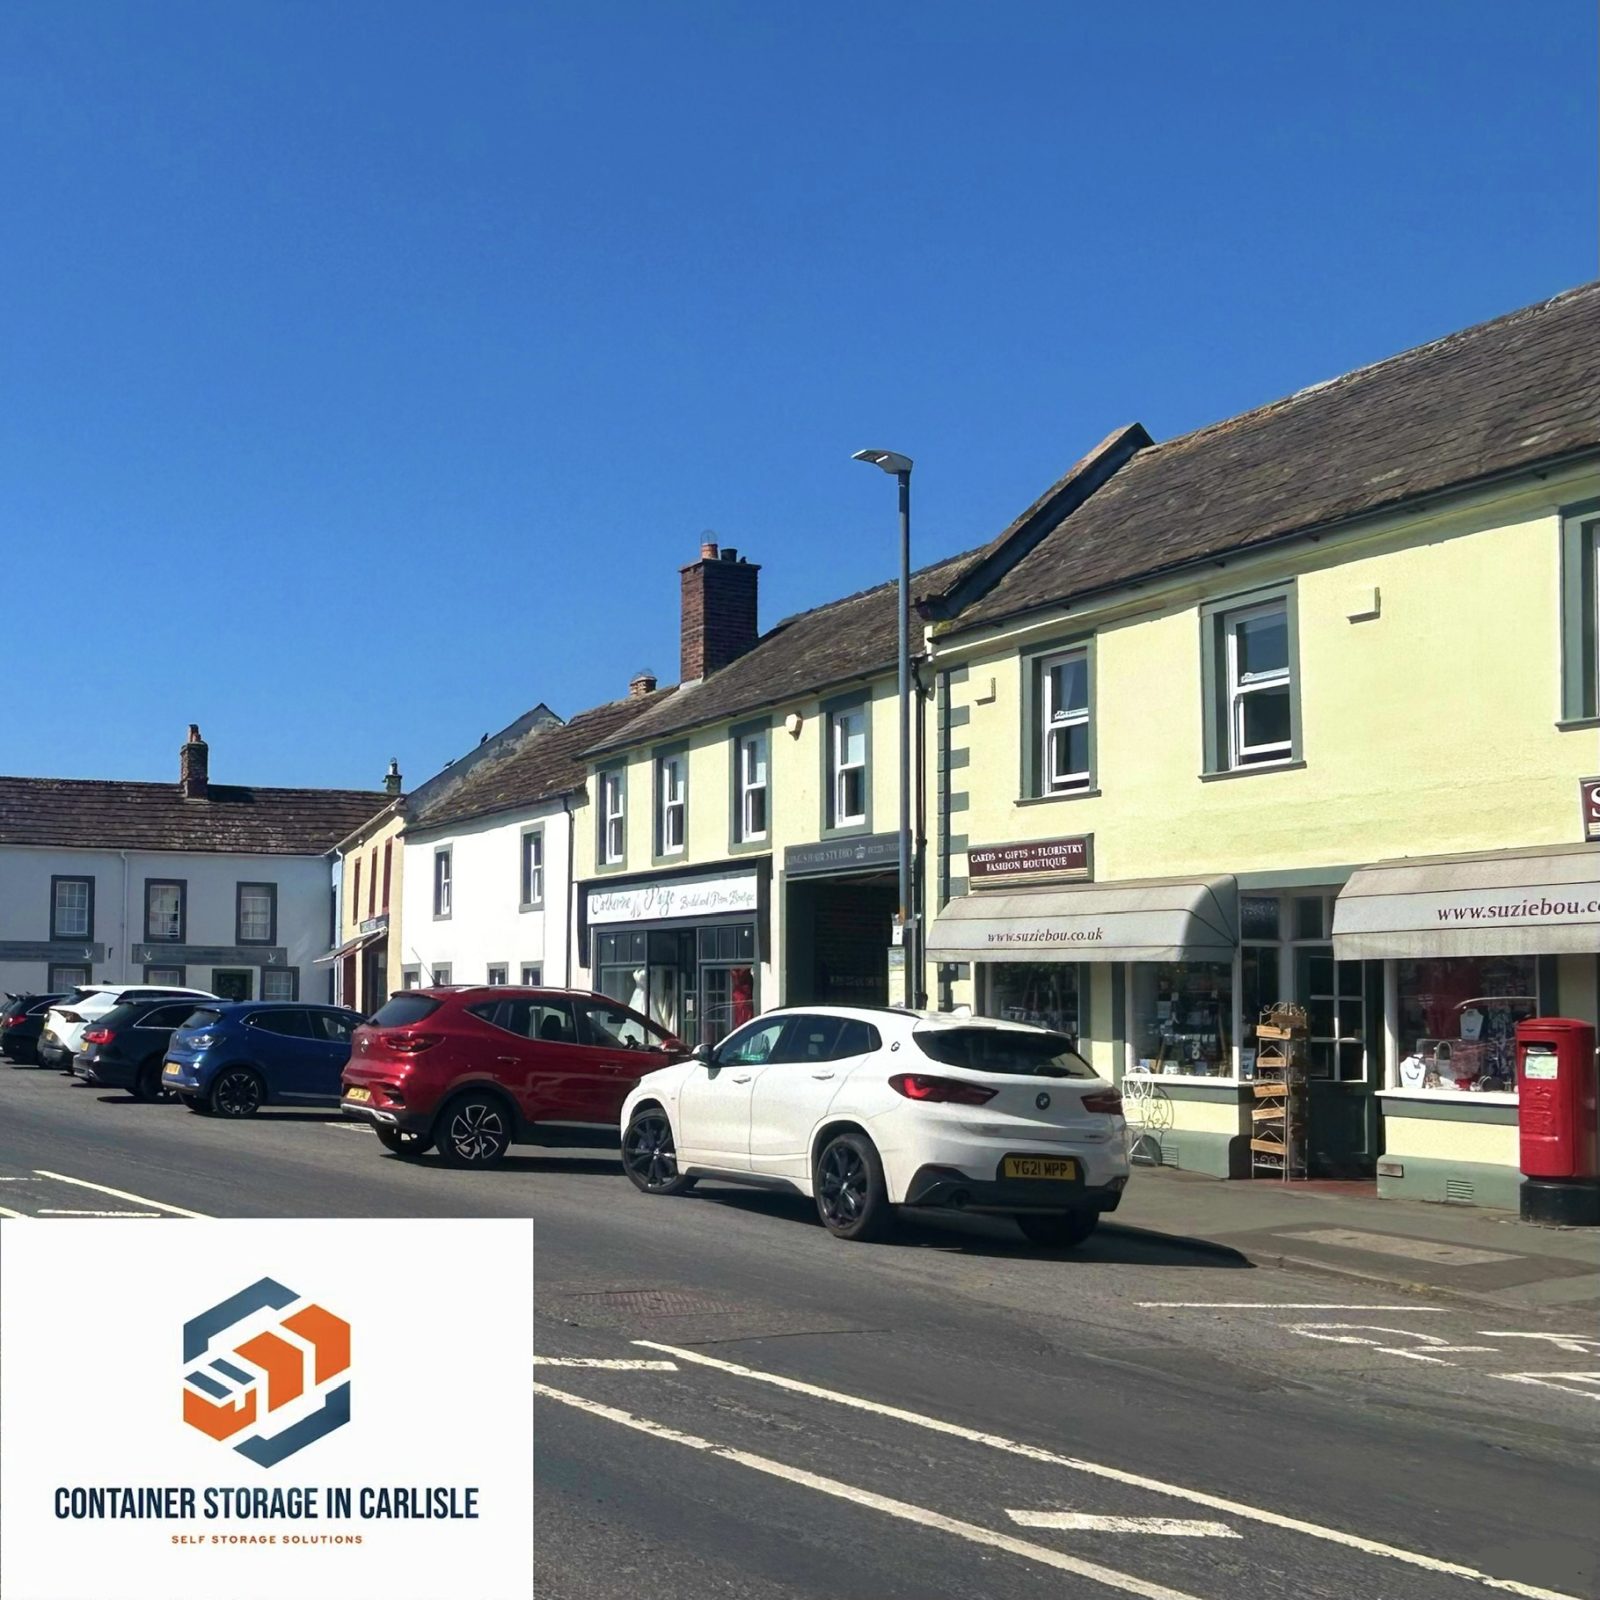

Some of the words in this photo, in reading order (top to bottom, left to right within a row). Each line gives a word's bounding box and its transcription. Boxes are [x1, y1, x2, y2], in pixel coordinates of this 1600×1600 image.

[970, 853, 996, 863] CARDS
[1005, 849, 1028, 859] GIFTS
[1038, 844, 1083, 857] FLORISTRY
[986, 860, 1020, 872] FASHION
[1022, 857, 1067, 869] BOUTIQUE
[987, 927, 1104, 942] www.suziebou.co.uk
[1013, 1160, 1041, 1176] YG21
